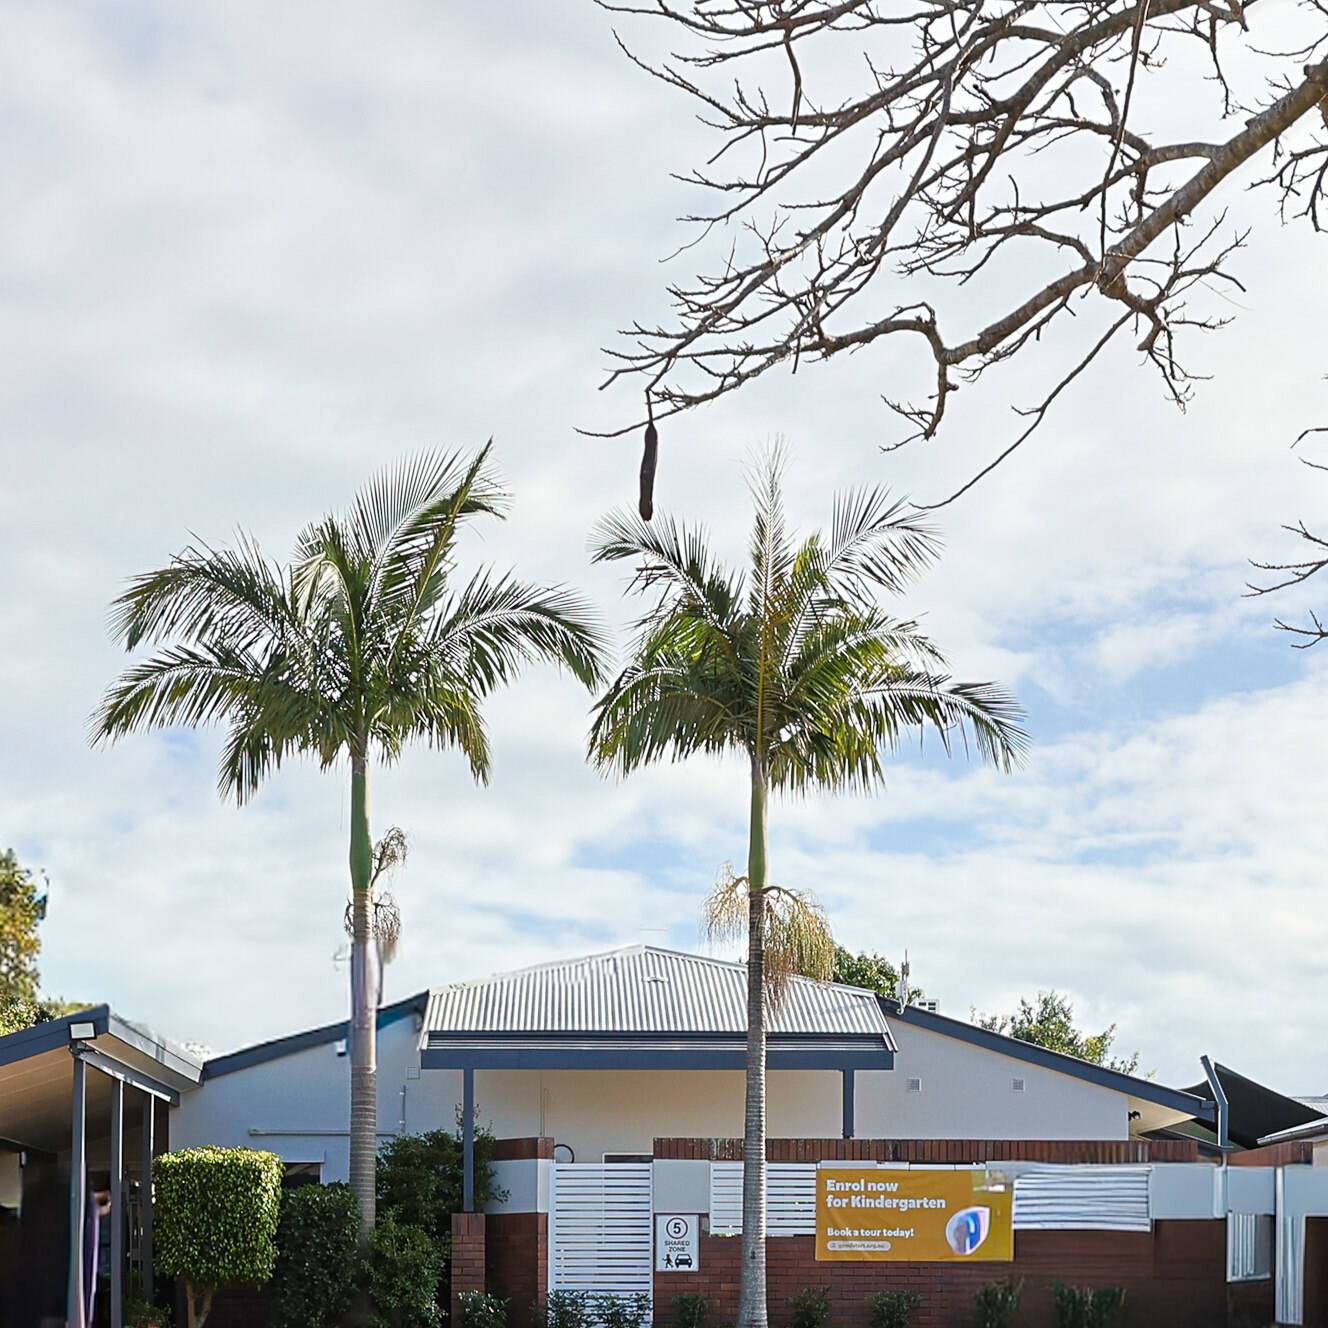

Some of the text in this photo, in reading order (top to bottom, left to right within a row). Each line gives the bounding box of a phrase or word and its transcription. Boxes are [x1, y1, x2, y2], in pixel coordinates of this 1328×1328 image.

[826, 1179, 899, 1192] Enrol now
[826, 1195, 947, 1212] for Kindergarten
[673, 1222, 682, 1234] 5
[827, 1227, 914, 1238] Book a tour today!
